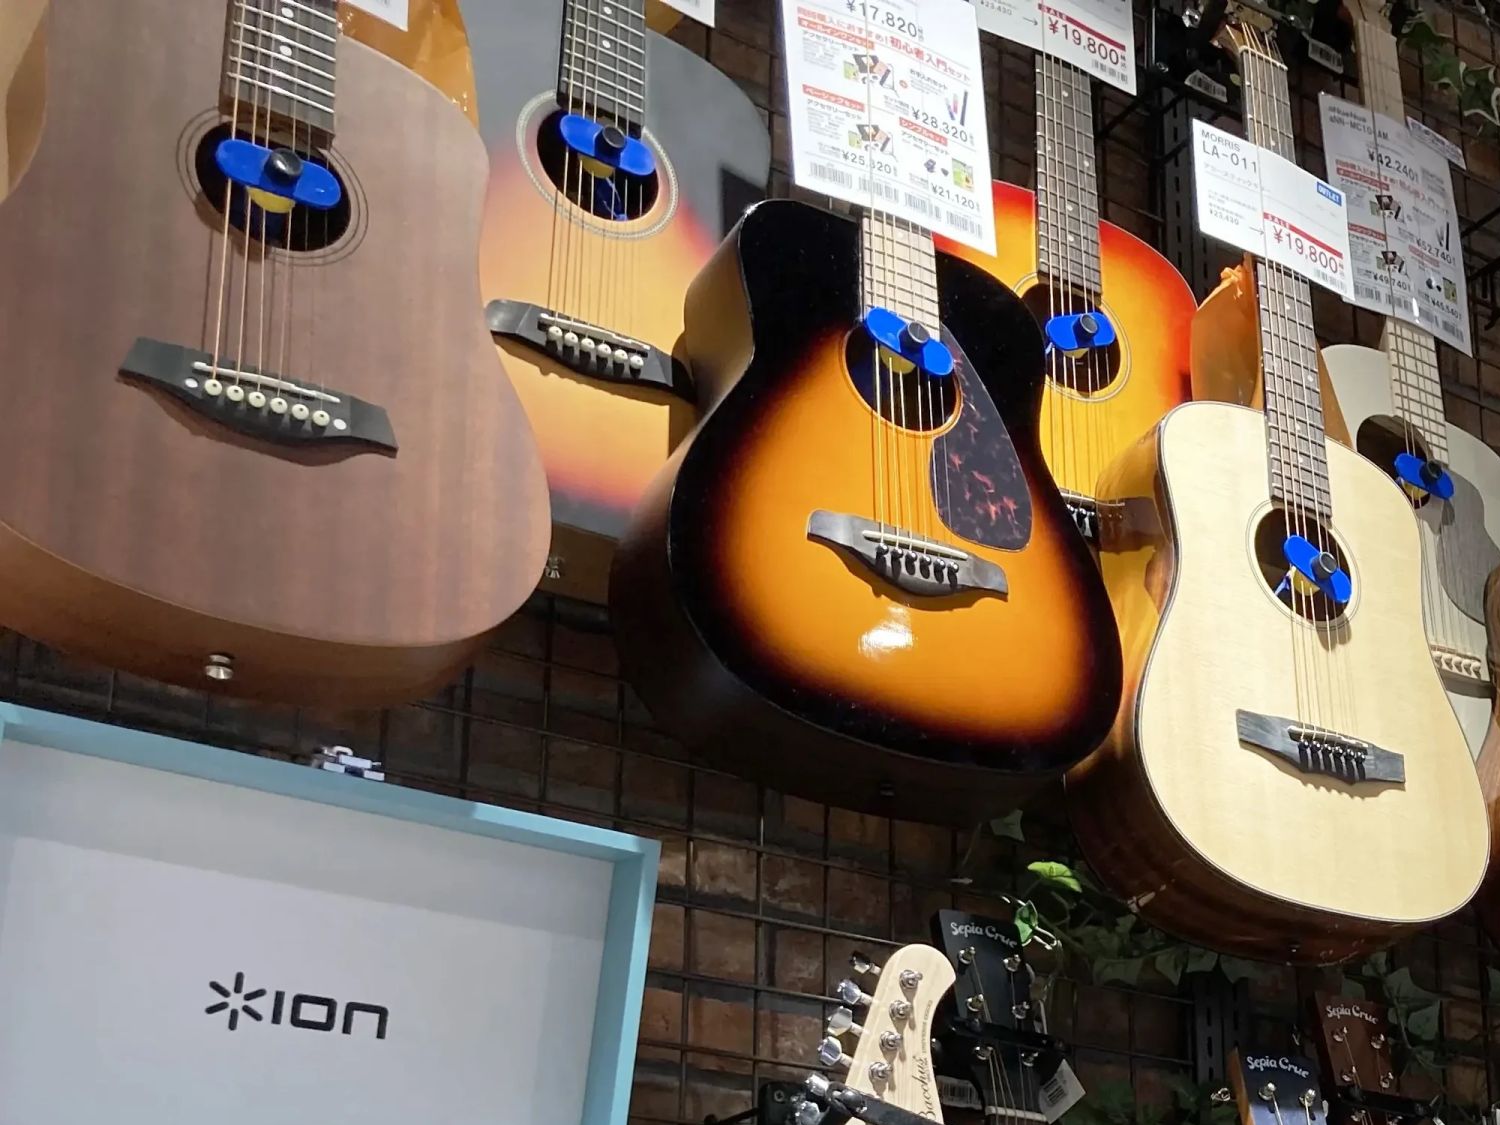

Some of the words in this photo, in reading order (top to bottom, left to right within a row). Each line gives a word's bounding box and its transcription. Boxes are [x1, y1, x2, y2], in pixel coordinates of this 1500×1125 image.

[1049, 17, 1119, 65] ¥19,800
[911, 106, 968, 143] ¥28,320
[1201, 129, 1241, 151] MORRIS
[1202, 141, 1258, 173] LA-011
[931, 182, 975, 210] ¥21,120
[1318, 184, 1342, 204] OUTLET
[1273, 226, 1338, 274] ¥19,800
[950, 922, 983, 938] Sepia
[985, 925, 1018, 949] Crue
[1325, 1003, 1351, 1019] Sepia
[1352, 1004, 1379, 1024] Crue
[1247, 1055, 1277, 1071] Sepia
[1279, 1057, 1310, 1078] Crue
